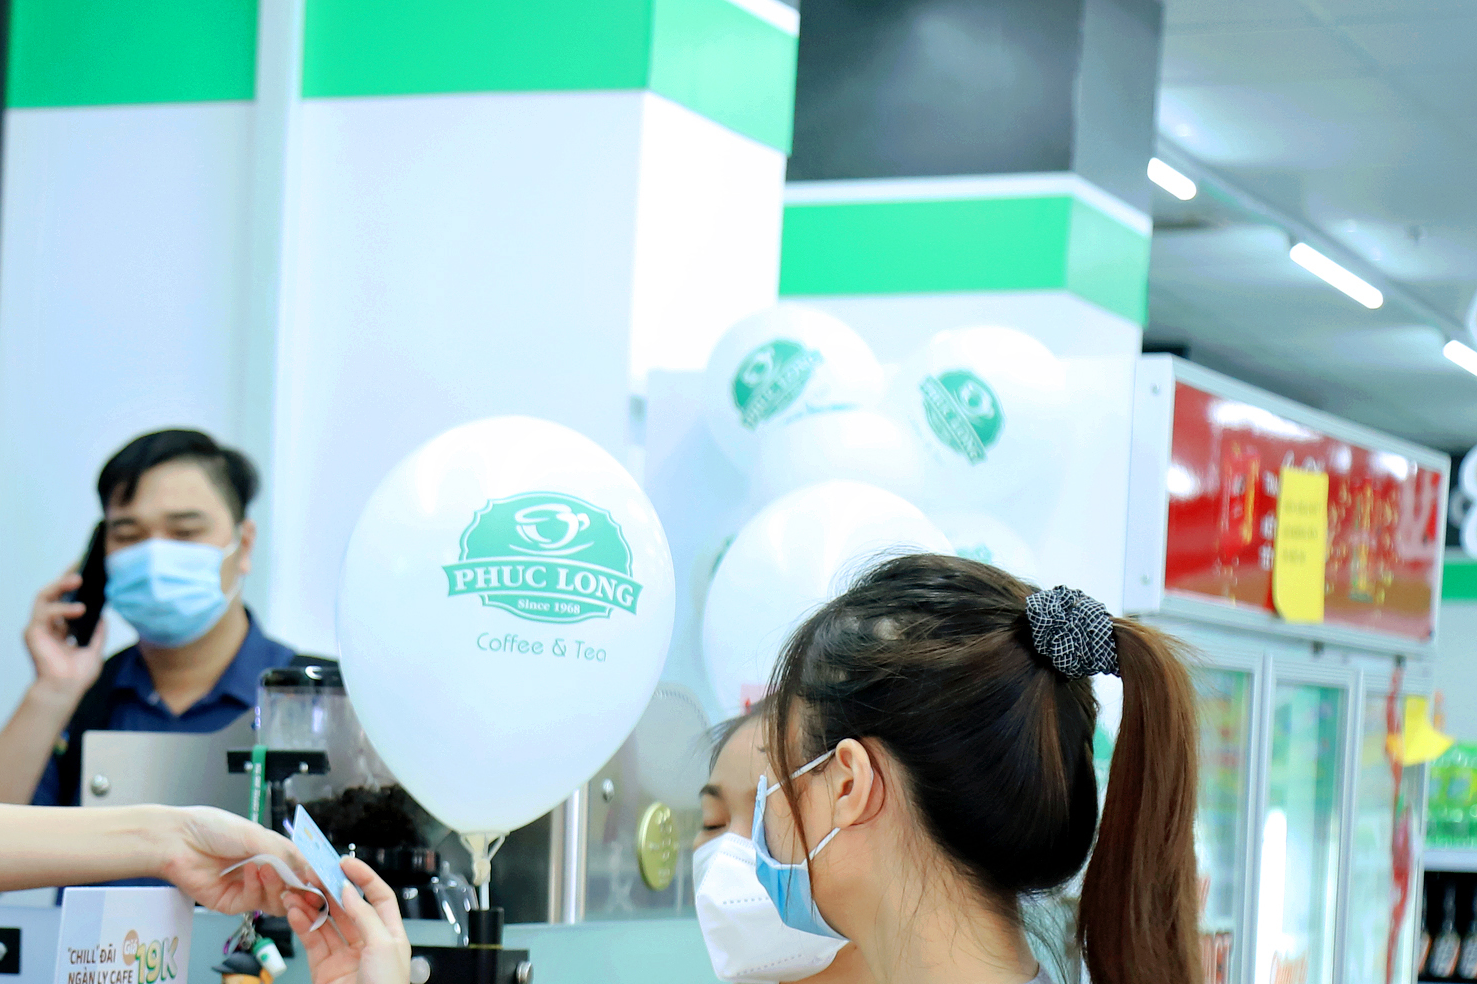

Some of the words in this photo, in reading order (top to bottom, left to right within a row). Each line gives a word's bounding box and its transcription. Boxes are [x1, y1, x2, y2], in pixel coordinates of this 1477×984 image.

[454, 565, 547, 592] PHUC
[557, 567, 635, 608] LONG
[518, 598, 550, 612] Since
[554, 600, 581, 614] 1968
[477, 632, 544, 655] Coffee
[552, 638, 567, 657] &
[574, 640, 607, 662] Tea
[110, 970, 134, 984] CAFE
